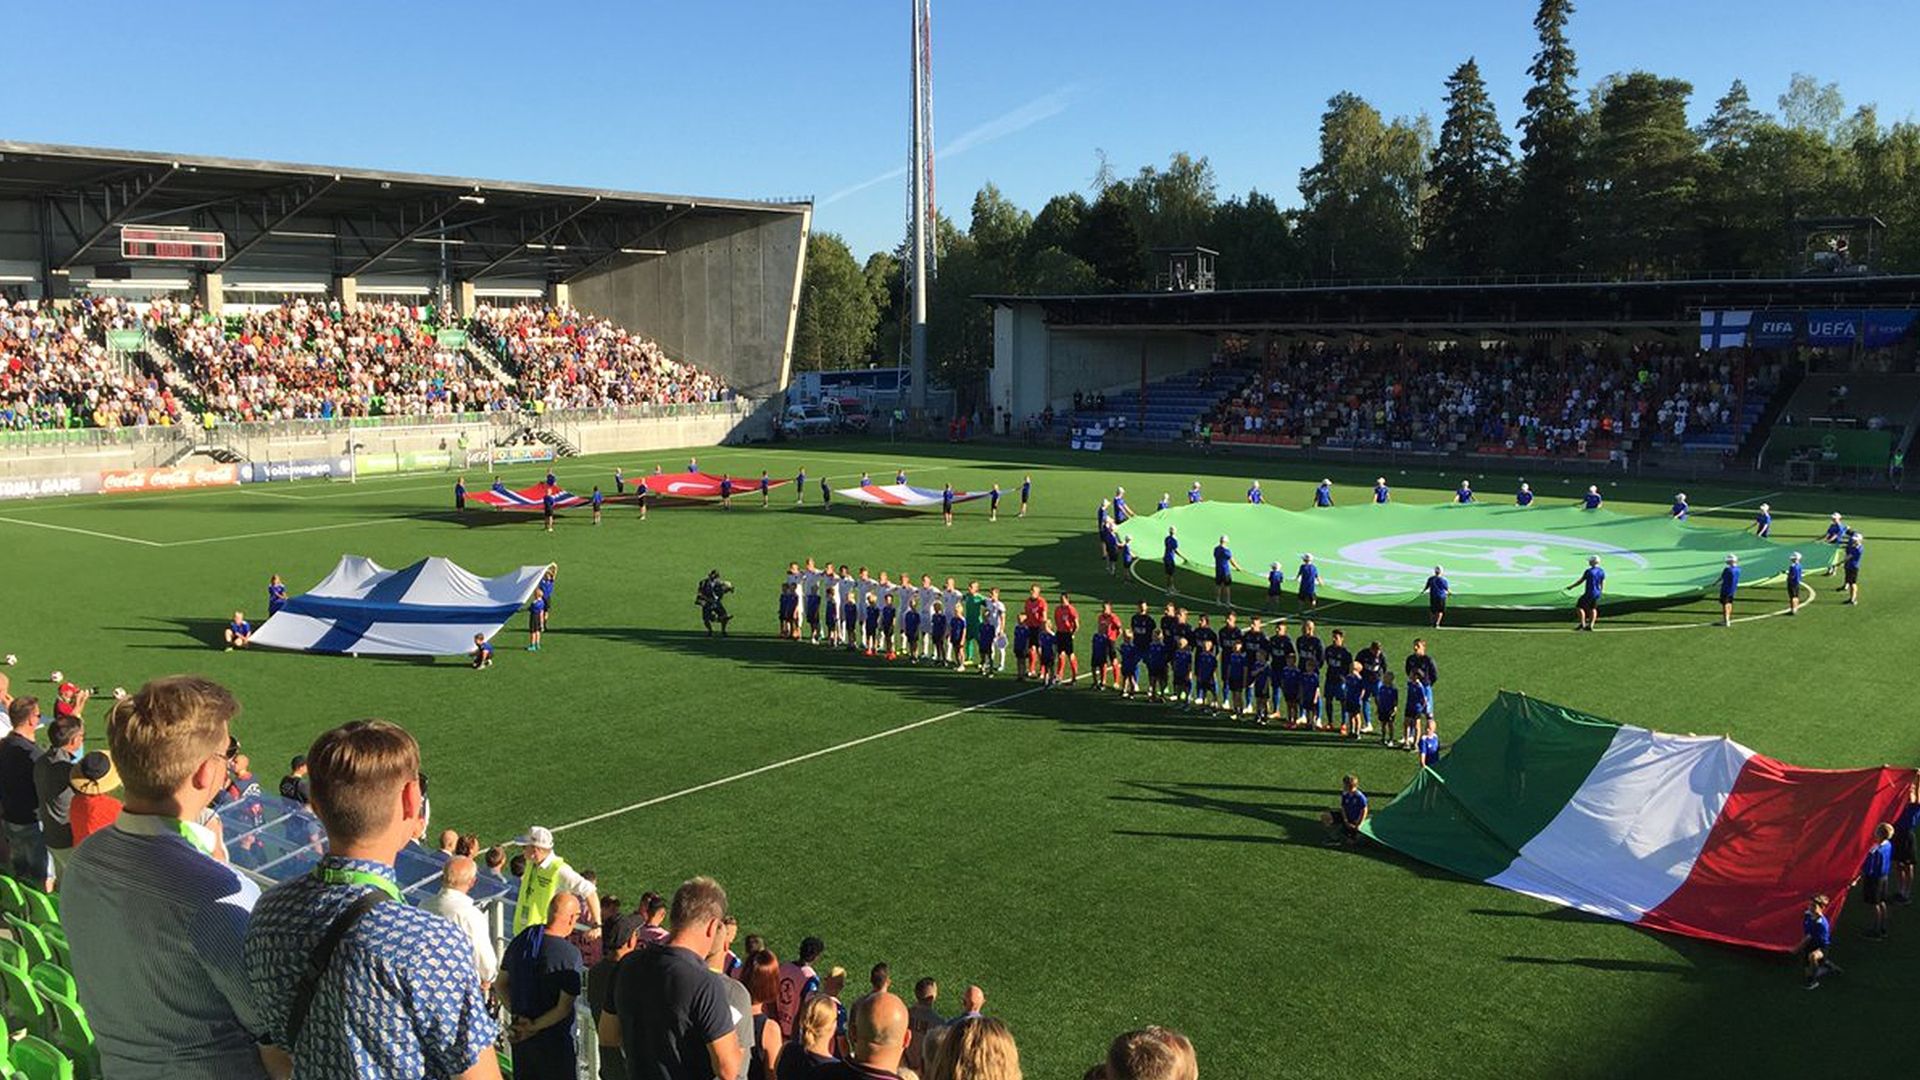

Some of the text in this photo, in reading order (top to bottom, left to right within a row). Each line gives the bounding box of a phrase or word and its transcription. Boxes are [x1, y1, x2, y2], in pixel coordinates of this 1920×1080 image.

[1762, 322, 1793, 333] FIFA
[1808, 322, 1856, 336] UEFA
[41, 477, 81, 493] GAME
